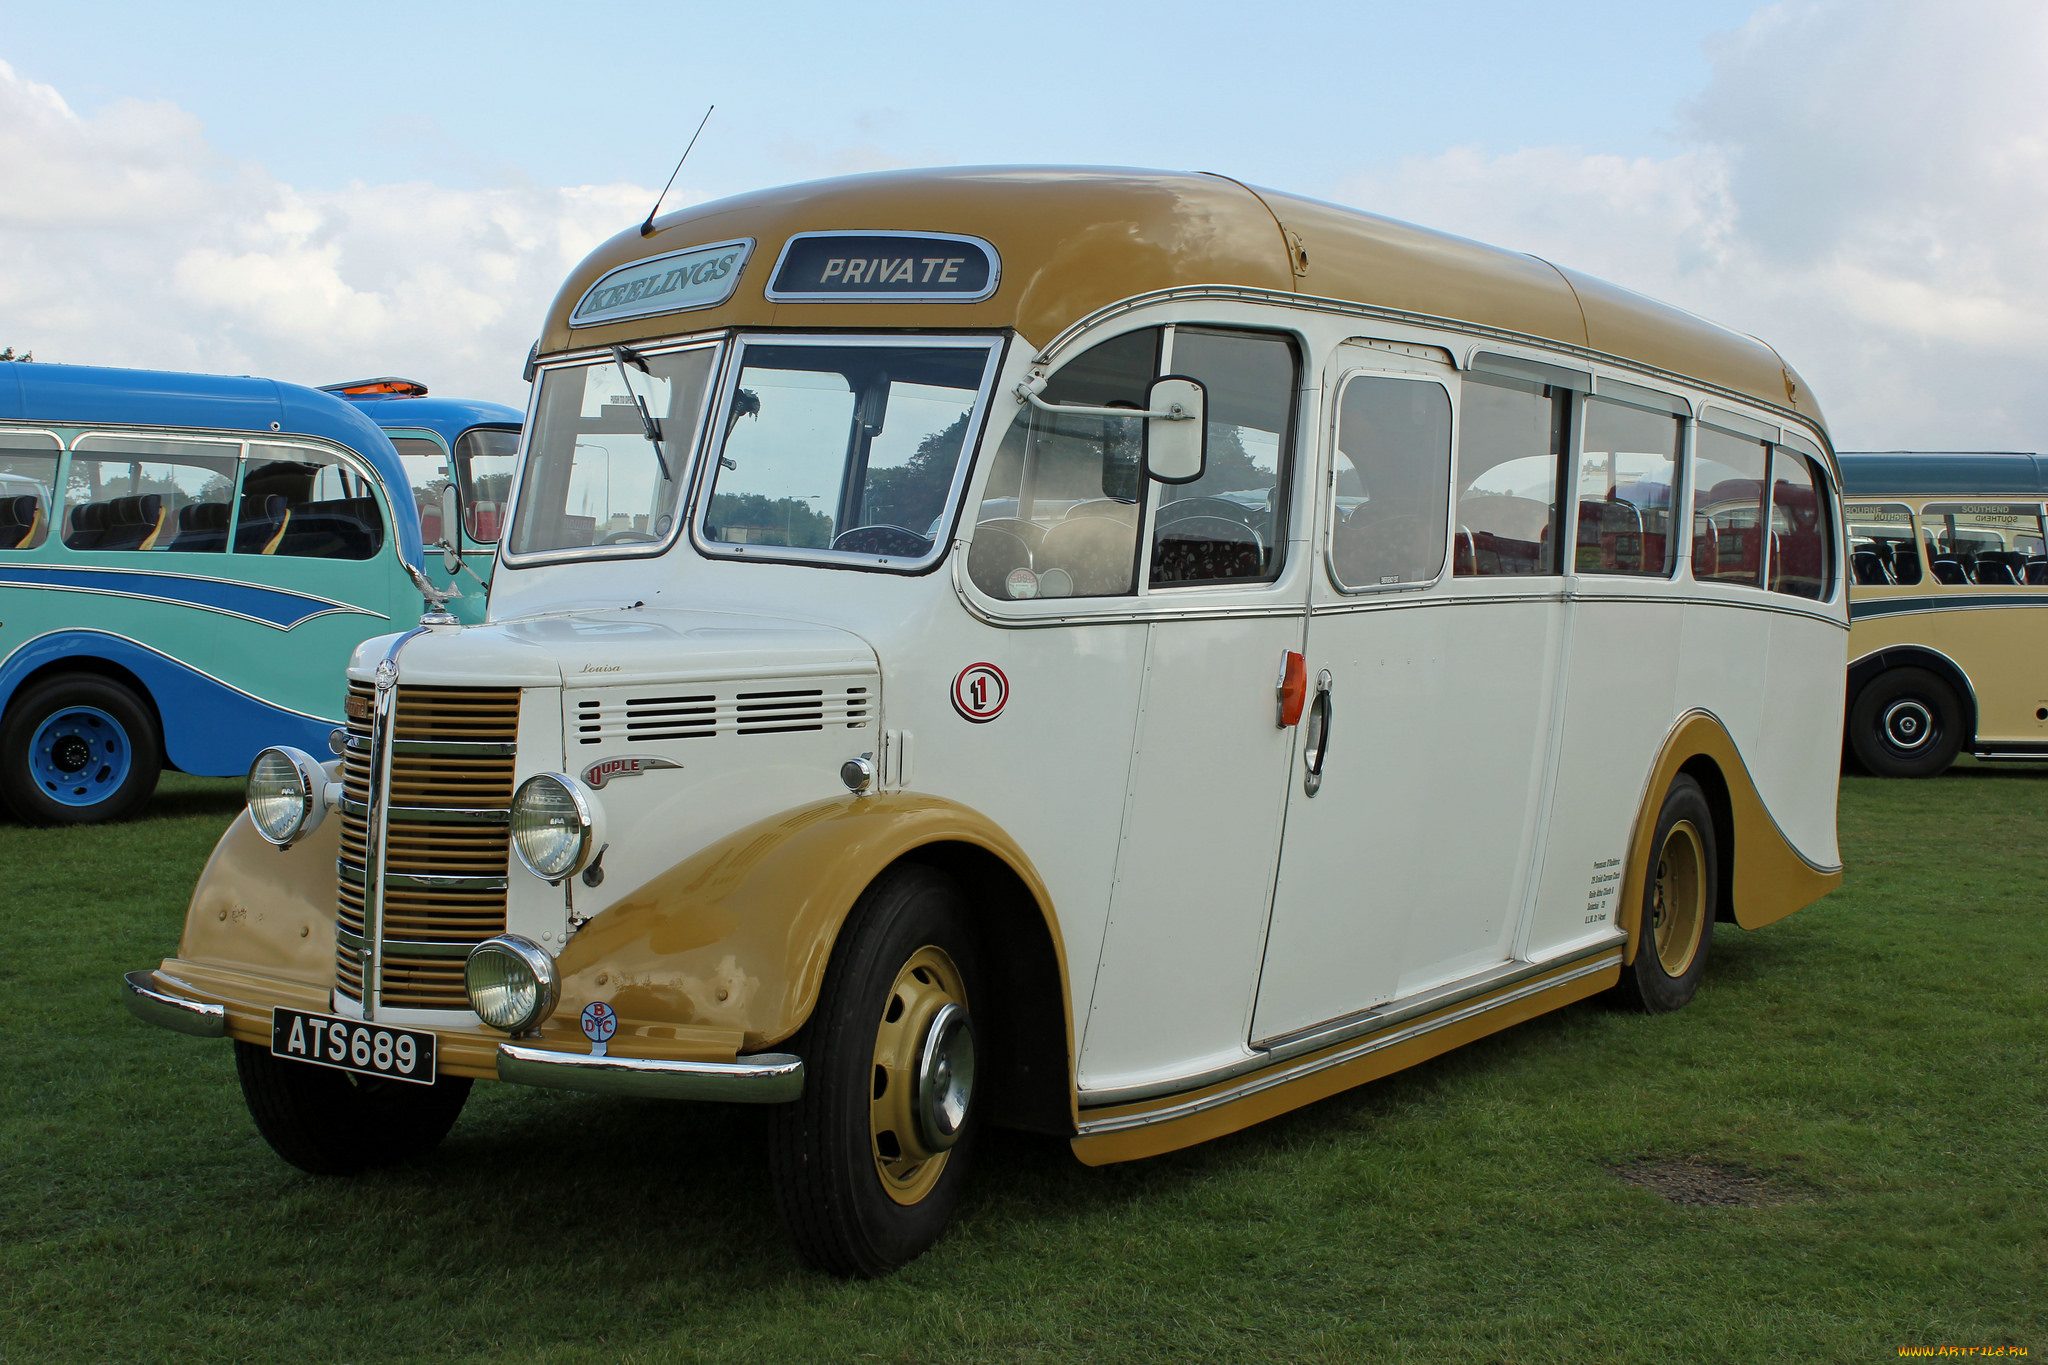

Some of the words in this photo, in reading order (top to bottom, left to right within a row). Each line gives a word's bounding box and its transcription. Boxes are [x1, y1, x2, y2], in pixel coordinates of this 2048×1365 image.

[582, 252, 738, 315] KEELINGS
[819, 257, 966, 284] PRIVATE
[1961, 505, 2010, 513] SOUTHEND
[578, 663, 622, 674] Louisa
[589, 759, 640, 785] DUPLE
[287, 1015, 417, 1074] ATS689
